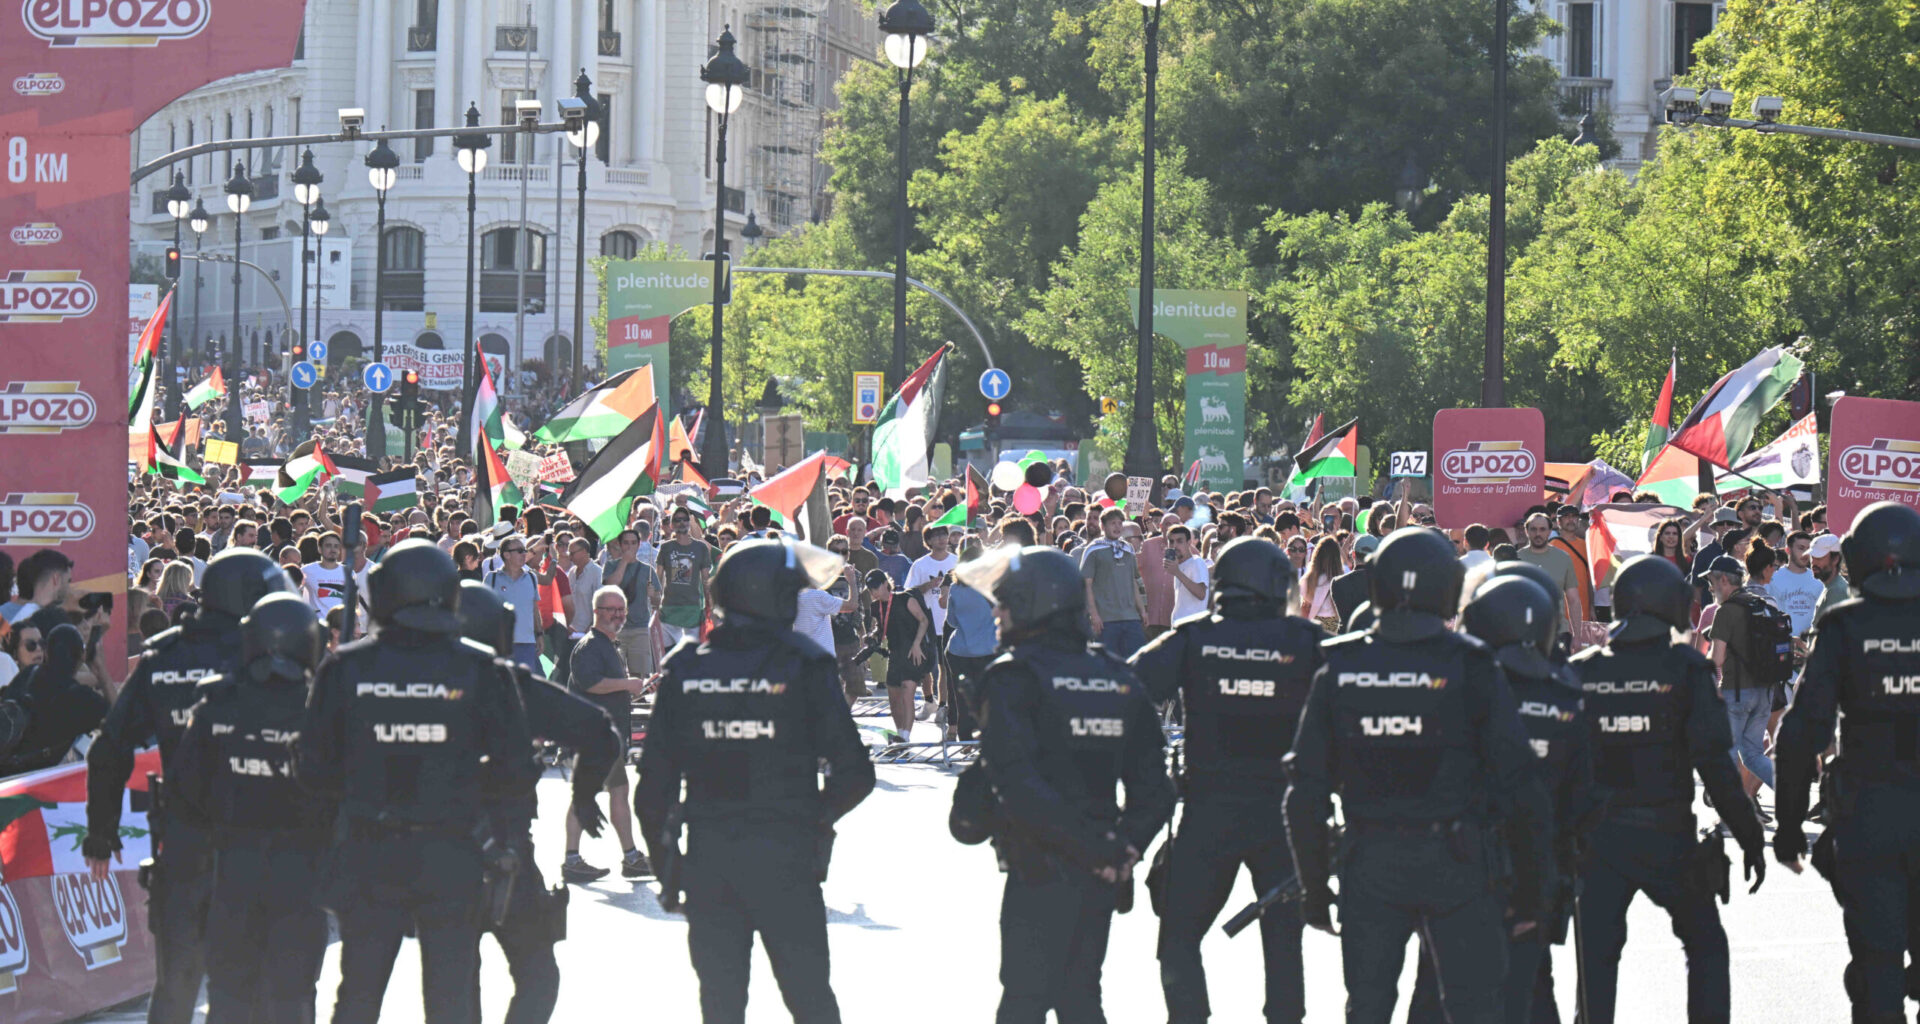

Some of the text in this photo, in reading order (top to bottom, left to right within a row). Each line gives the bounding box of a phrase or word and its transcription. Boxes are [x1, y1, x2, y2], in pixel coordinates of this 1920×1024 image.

[8, 136, 68, 183] 8 KM
[617, 272, 710, 291] plenitude
[0, 287, 90, 310] LPOZO
[624, 323, 652, 340] 10 KM
[420, 353, 429, 362] EL
[1203, 352, 1230, 369] 10 KM
[0, 398, 89, 421] LPOZO
[1194, 427, 1235, 436] plenitude
[1392, 455, 1425, 475] PAZ
[1442, 484, 1537, 495] Uno más de la familia
[1839, 487, 1861, 498] Uno
[1865, 490, 1885, 500] más
[1888, 491, 1901, 501] de
[1903, 493, 1913, 502] la
[0, 510, 88, 532] LPOZO
[1201, 645, 1283, 663] POLICIA
[1864, 638, 1920, 653] POLI
[683, 679, 772, 694] POLICIA
[1052, 677, 1120, 693] POLICIA
[1338, 672, 1432, 688] POLICIA
[1882, 675, 1920, 694] 1U10
[357, 683, 448, 699] POLICIA
[1360, 716, 1422, 736] 1U104
